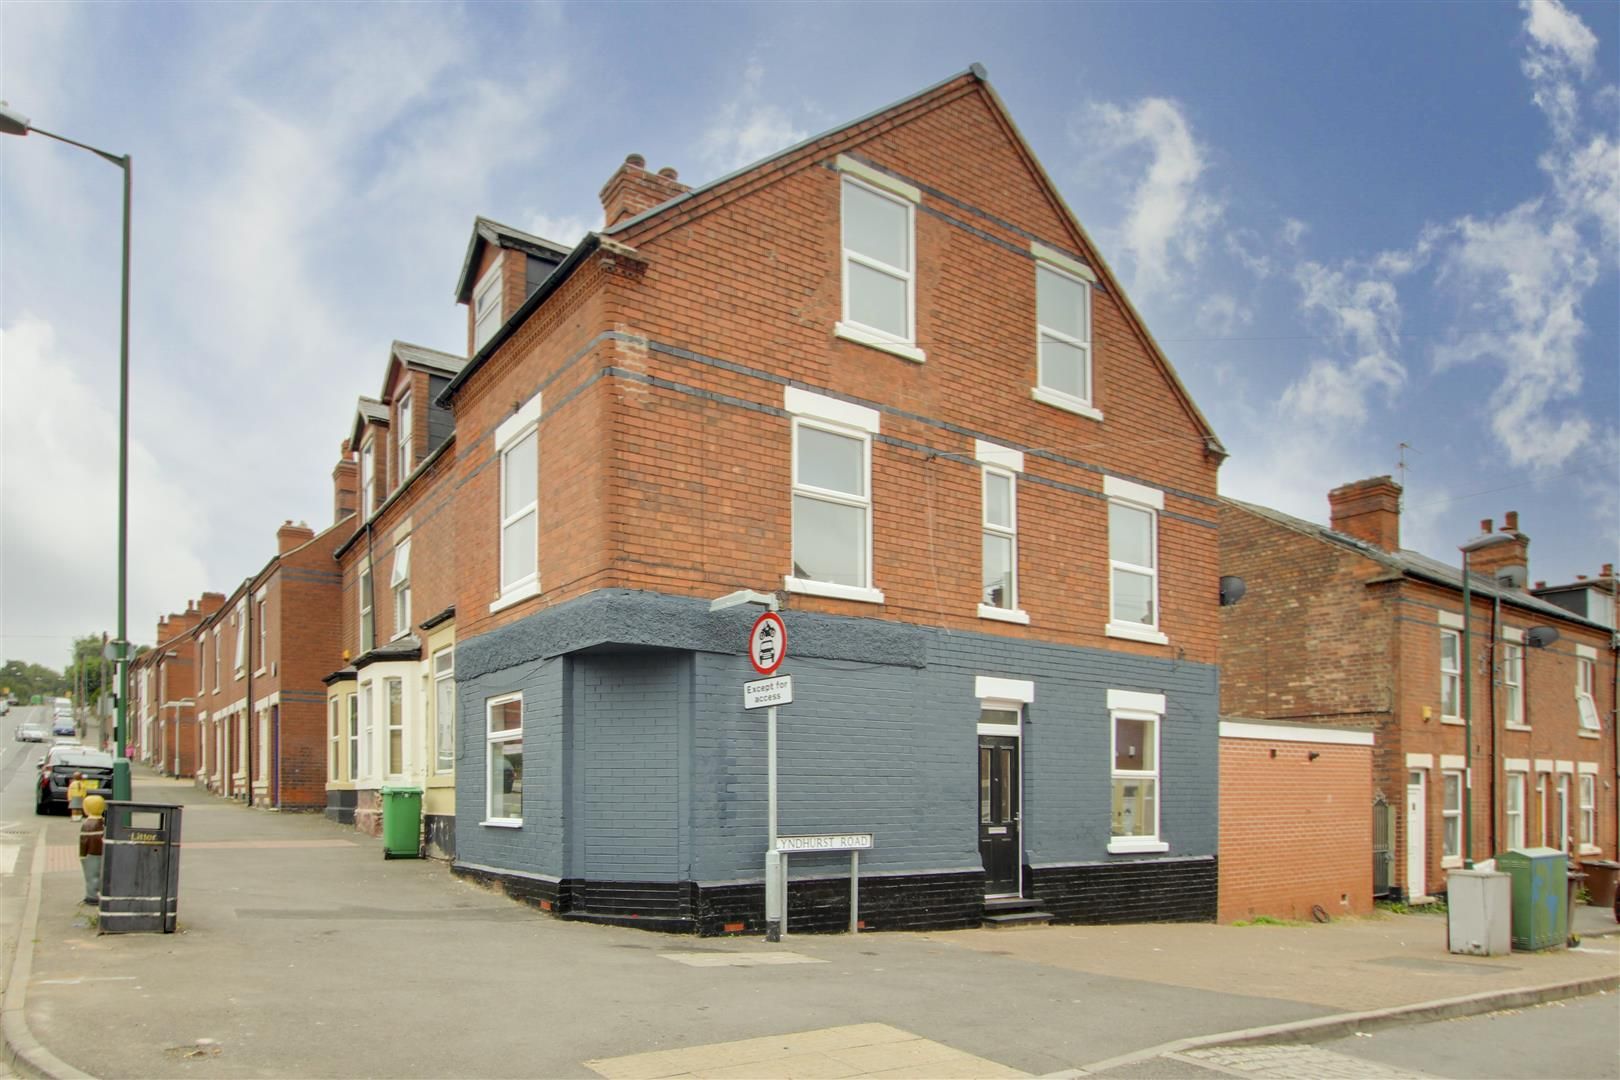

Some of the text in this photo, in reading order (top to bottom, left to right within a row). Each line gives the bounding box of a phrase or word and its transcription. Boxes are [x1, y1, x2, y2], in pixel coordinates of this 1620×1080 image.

[747, 680, 788, 695] Except for
[755, 693, 781, 703] access
[131, 832, 157, 841] Litter
[840, 836, 868, 847] ROAD
